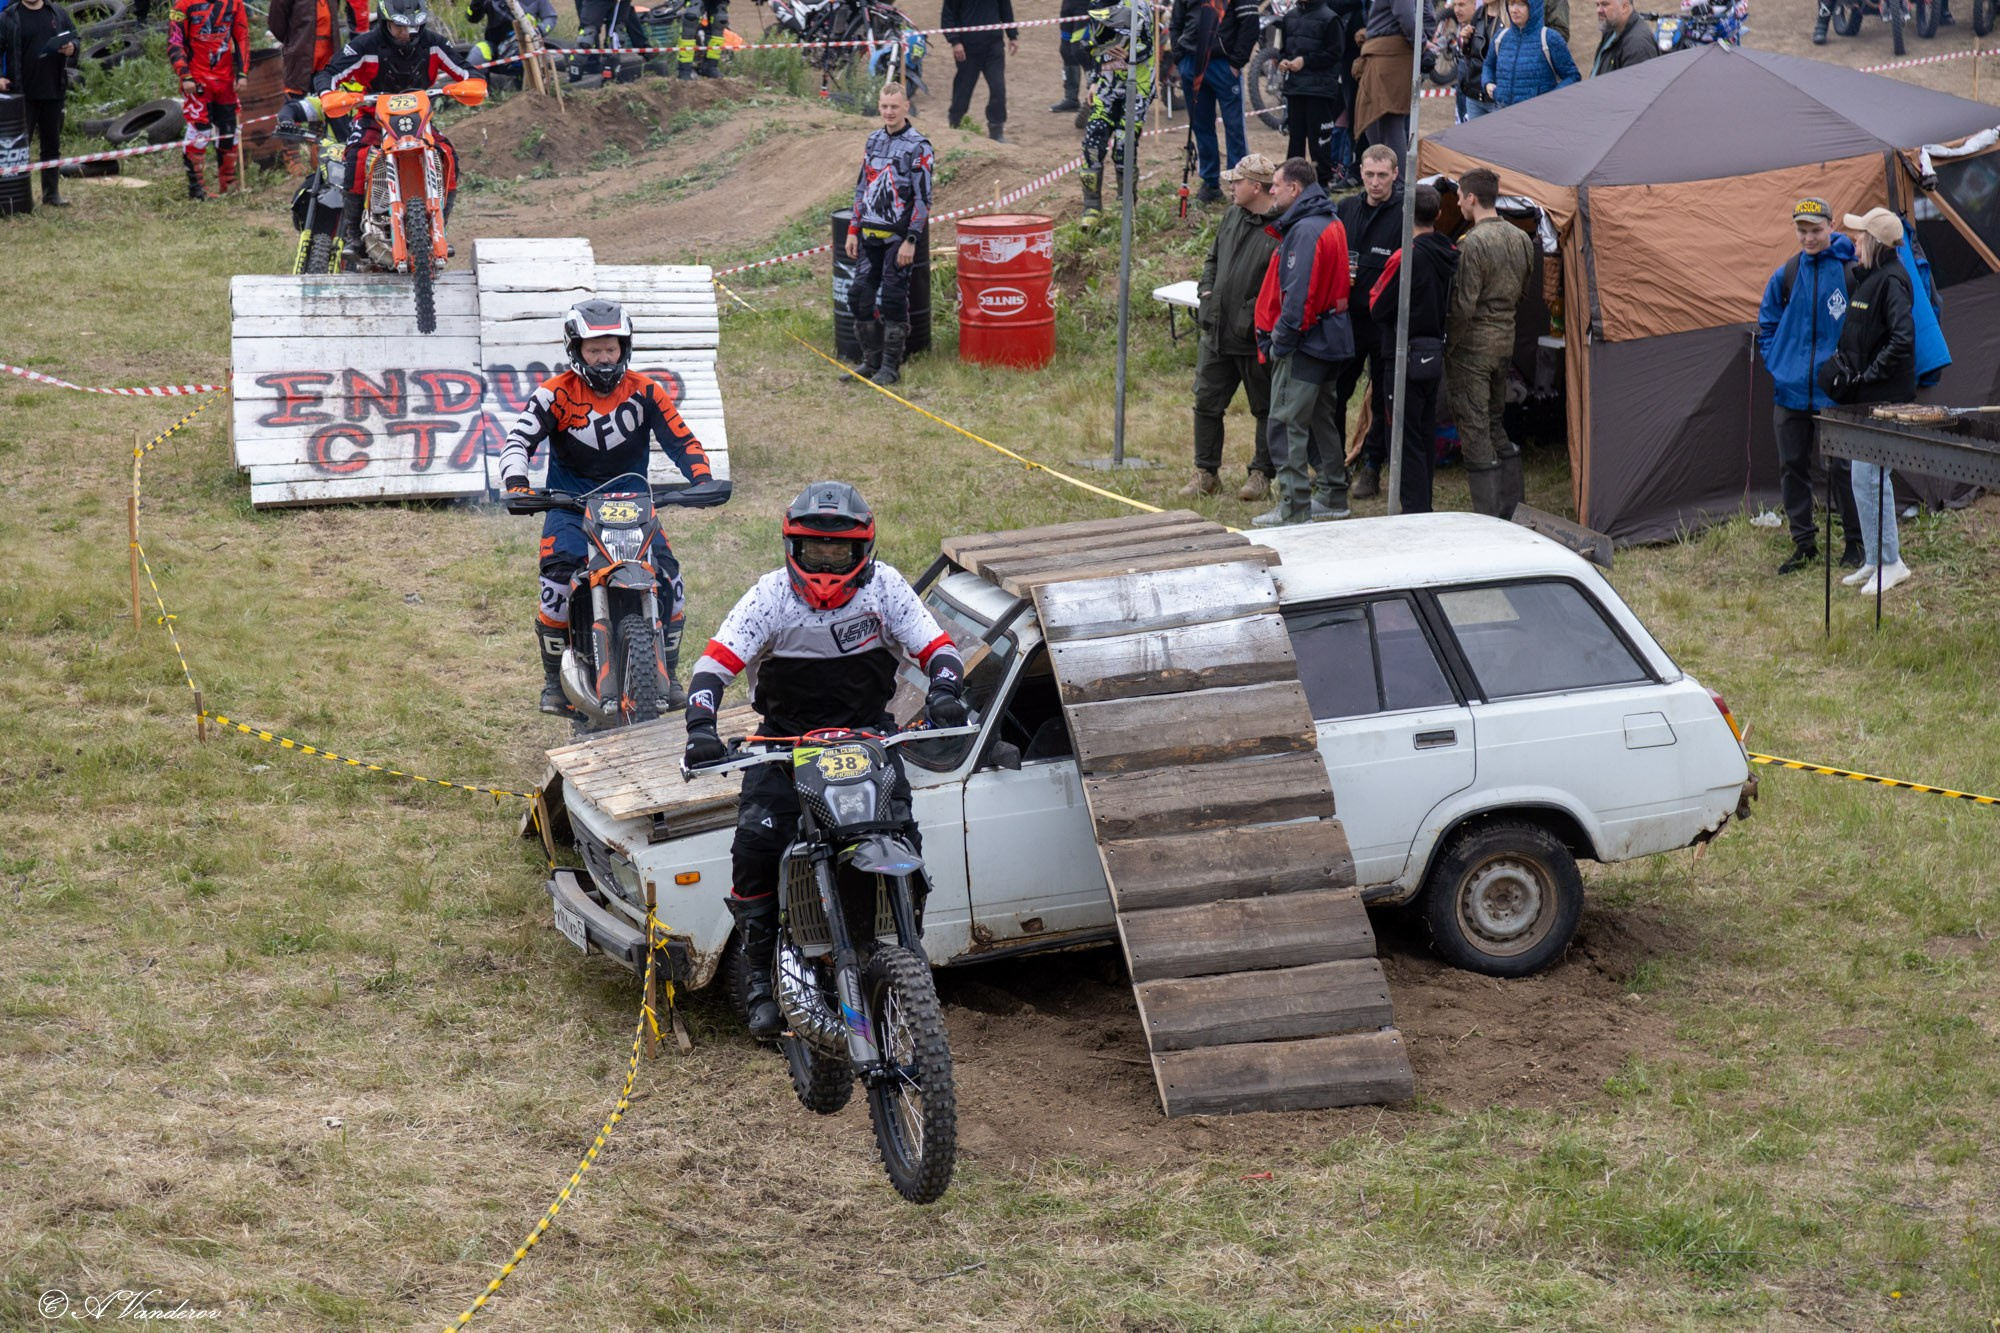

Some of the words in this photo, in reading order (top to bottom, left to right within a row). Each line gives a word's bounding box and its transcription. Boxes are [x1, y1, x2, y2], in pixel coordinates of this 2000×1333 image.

[979, 295, 1025, 306] SINTEC
[256, 361, 686, 428] ENDUO
[609, 507, 628, 518] 24
[541, 580, 567, 613] OX
[832, 756, 857, 770] 38
